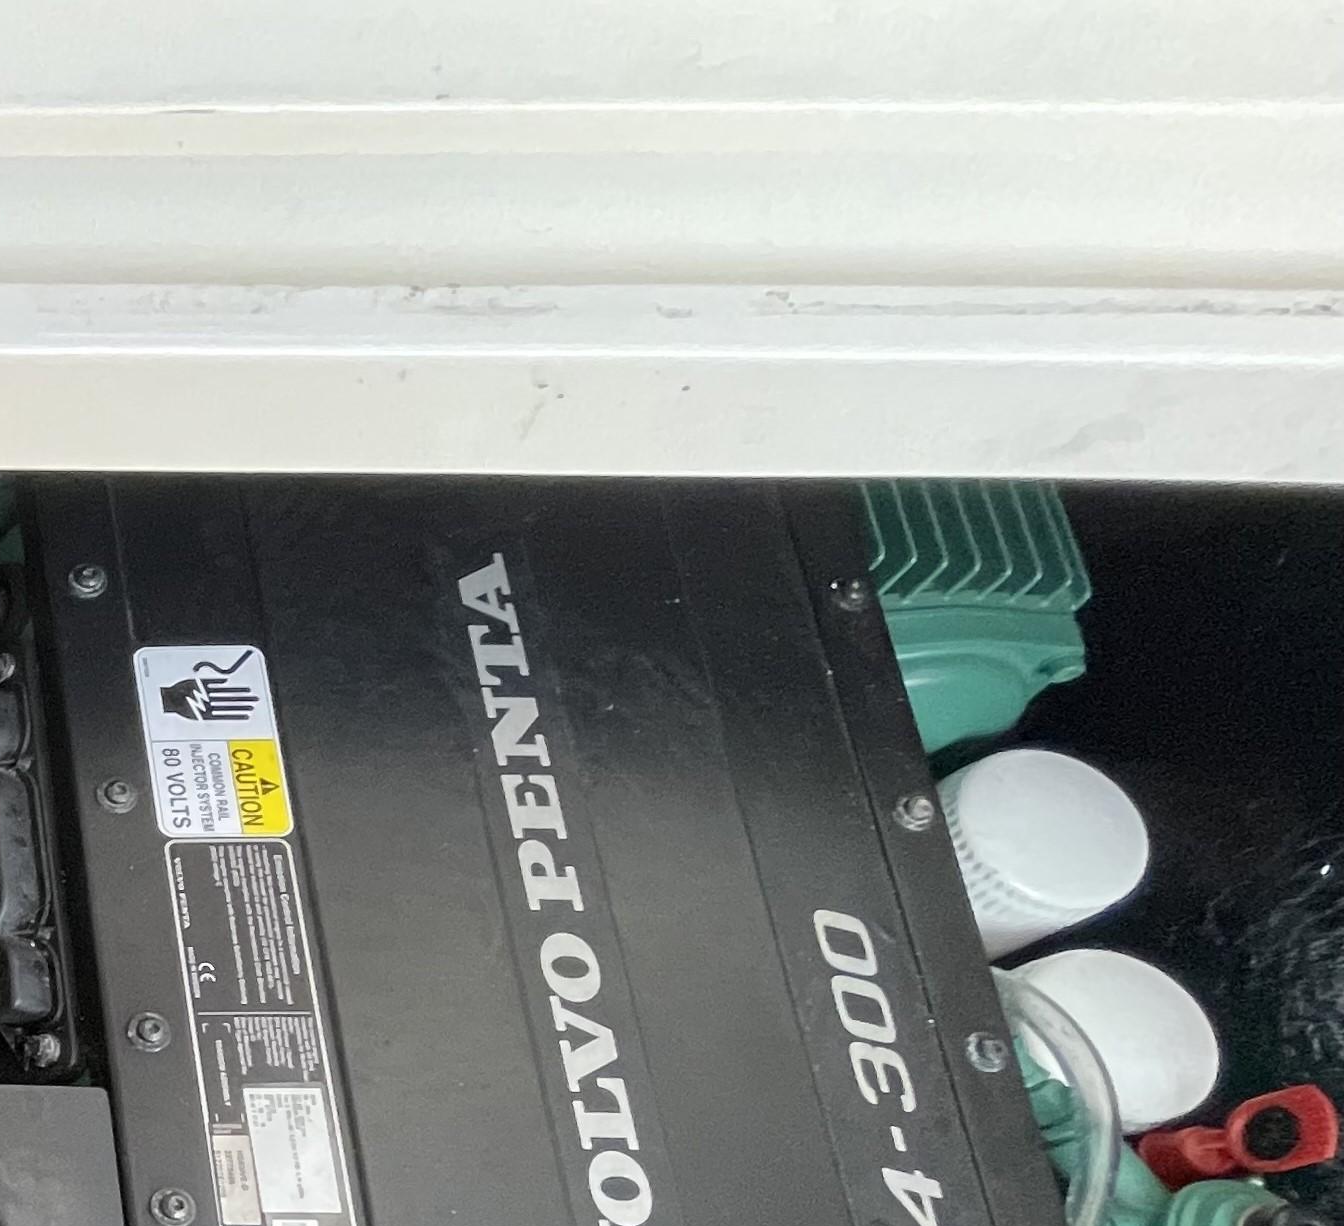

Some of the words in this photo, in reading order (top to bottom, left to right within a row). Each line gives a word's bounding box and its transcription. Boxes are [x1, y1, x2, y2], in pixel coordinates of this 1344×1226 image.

[458, 553, 586, 912] PENTA
[162, 748, 182, 767] 80
[190, 743, 209, 791] INJECTOR
[208, 752, 226, 797] COMMON
[166, 772, 191, 829] VOLTS
[232, 748, 265, 826] CAUTION
[197, 792, 216, 832] SYSTEM
[216, 799, 230, 821] RAIL
[198, 962, 217, 983] CE
